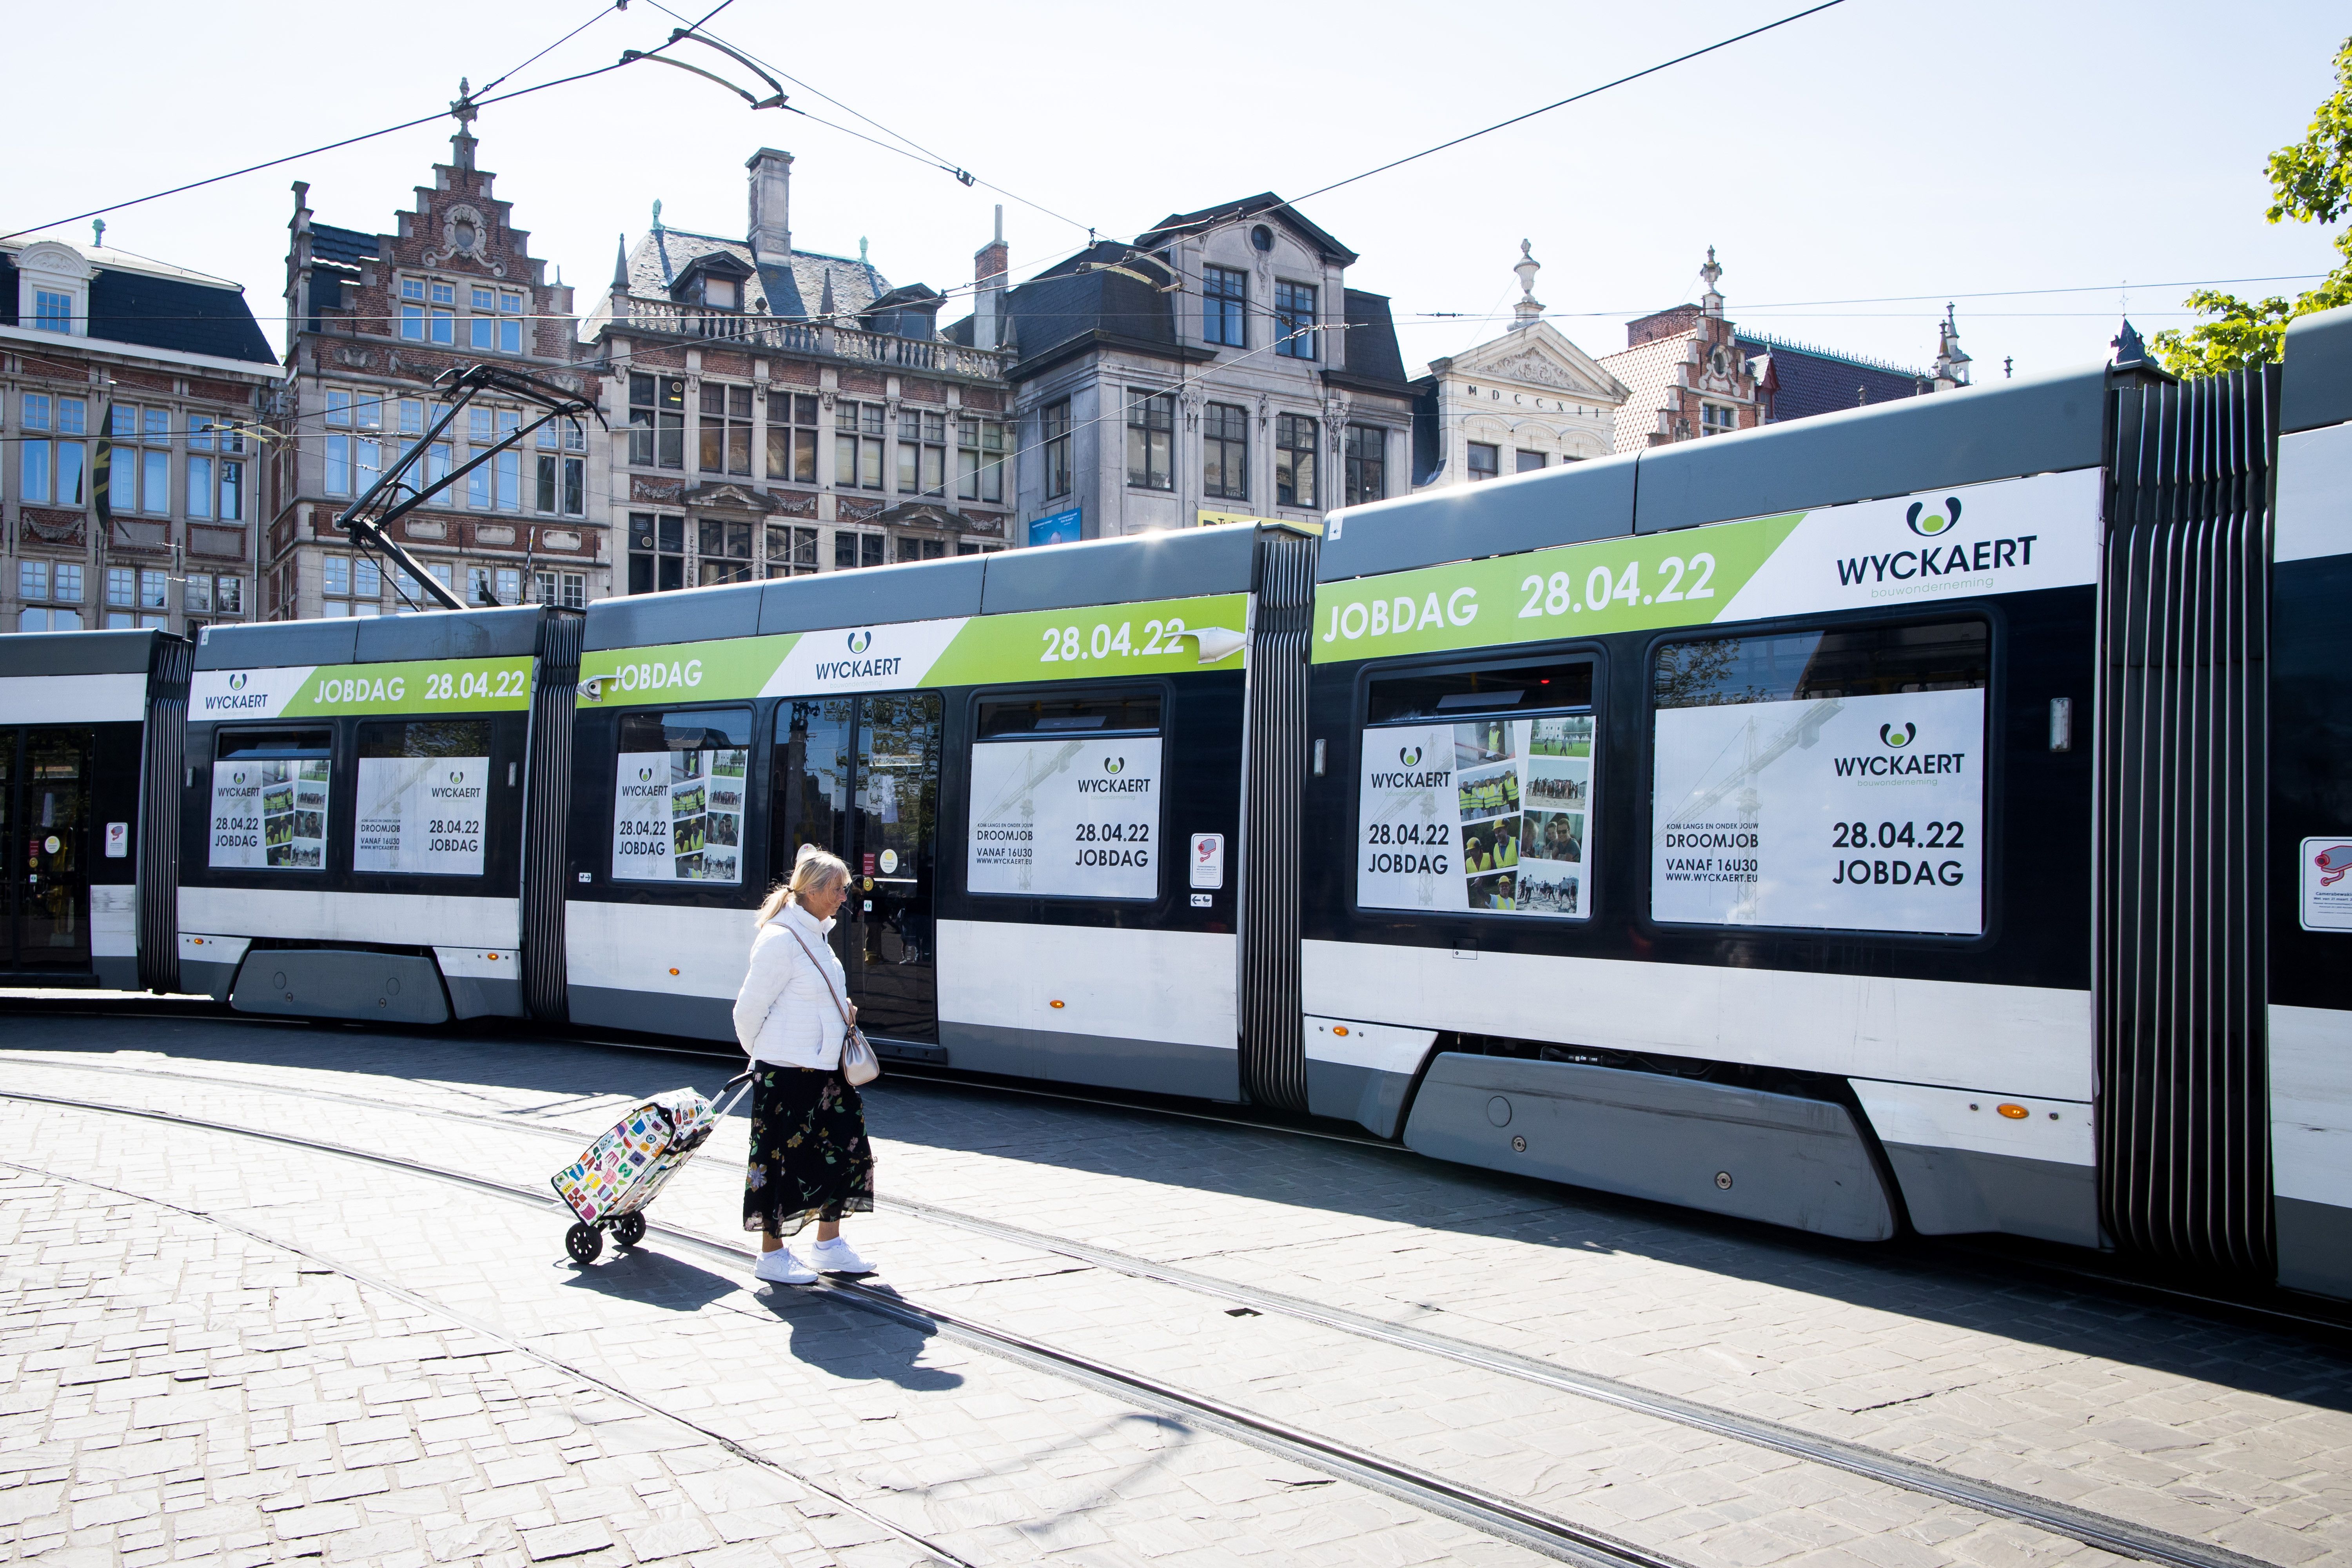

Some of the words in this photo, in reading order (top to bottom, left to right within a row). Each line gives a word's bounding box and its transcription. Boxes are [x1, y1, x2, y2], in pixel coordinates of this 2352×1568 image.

[1837, 535, 2038, 586] WYCKAERT
[1871, 577, 1994, 598] bouwonderneming
[1322, 586, 1479, 643] JOBDAG
[1517, 552, 1716, 619] 28.04.22
[1040, 618, 1185, 662] 28.04.22
[610, 659, 702, 692] JOBDAG
[816, 657, 901, 680] WYCKAERT
[314, 677, 405, 703] JOBDAG
[424, 670, 524, 699] 28.04.22
[829, 679, 882, 688] bouwonderneming
[206, 694, 268, 710] WYCKAERT
[1834, 753, 1965, 777] WYCKAERT
[1078, 779, 1151, 793] WYCKAERT
[1371, 771, 1451, 788] WYCKAERT
[218, 788, 260, 797] WYCKAERT
[432, 788, 481, 797] WYCKAERT
[622, 786, 668, 796] WYCKAERT
[216, 818, 258, 830] 28.04.22
[429, 820, 479, 833] 28.04.22
[619, 821, 666, 835] 28.04.22
[977, 830, 1033, 841] DROOMJOB
[1075, 824, 1149, 842] 28.04.22
[1368, 824, 1449, 845] 28.04.22
[1666, 833, 1759, 848] DROOMJOB
[1832, 821, 1964, 848] 28.04.22
[215, 835, 258, 847] JOBDAG
[429, 839, 478, 852] JOBDAG
[619, 841, 665, 855] JOBDAG
[977, 848, 1005, 857] VANAF
[1008, 848, 1032, 857] 16U30
[1075, 849, 1148, 867] JOBDAG
[1368, 853, 1448, 875] JOBDAG
[1666, 859, 1712, 871] VANAF
[1717, 859, 1758, 872] 16U30
[1666, 873, 1758, 882] WWW.WYCKAERT.EU
[1832, 860, 1964, 886] JOBDAG
